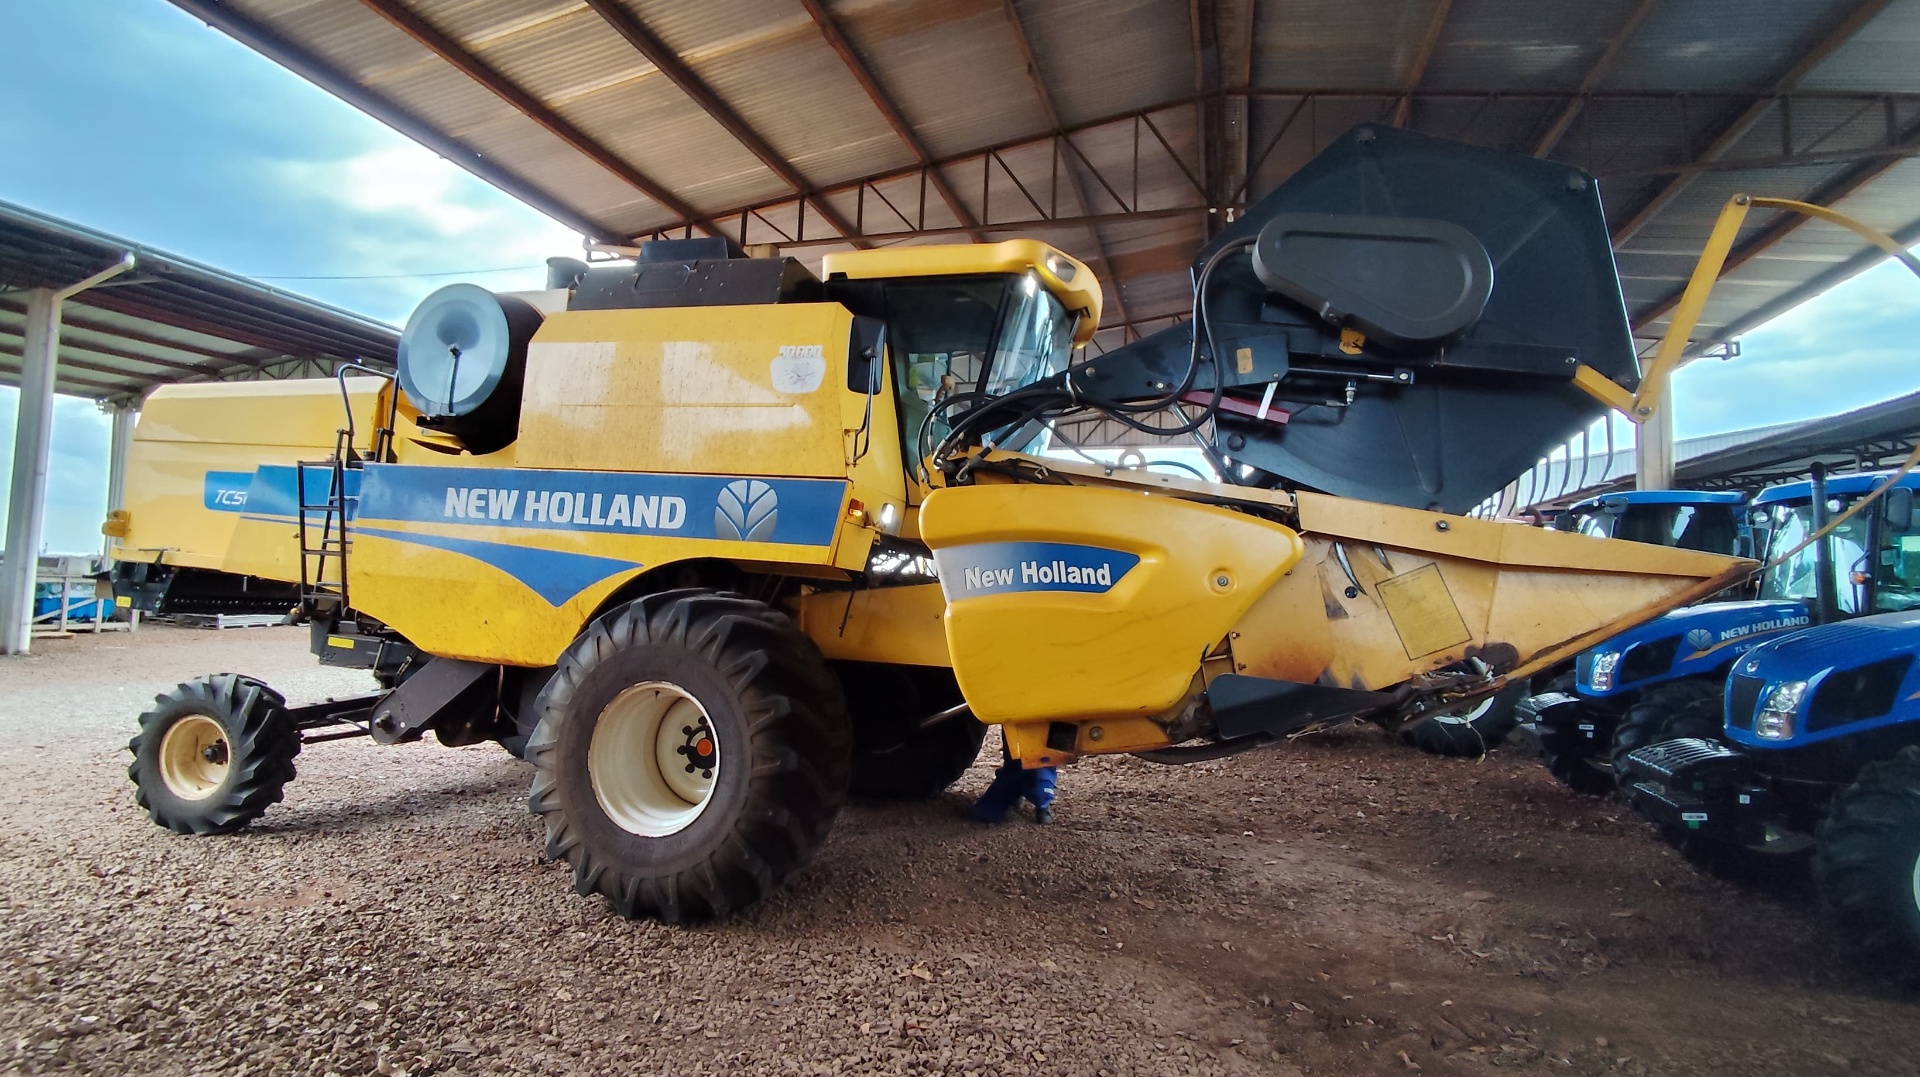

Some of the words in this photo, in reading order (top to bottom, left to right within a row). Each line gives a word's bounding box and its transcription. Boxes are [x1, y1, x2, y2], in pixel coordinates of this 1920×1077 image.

[444, 487, 519, 520] NEW
[524, 490, 687, 529] HOLLAND
[964, 566, 1014, 590] New
[1020, 560, 1112, 586] Holland
[1721, 625, 1749, 640] NEW
[1752, 616, 1810, 632] HOLLAND
